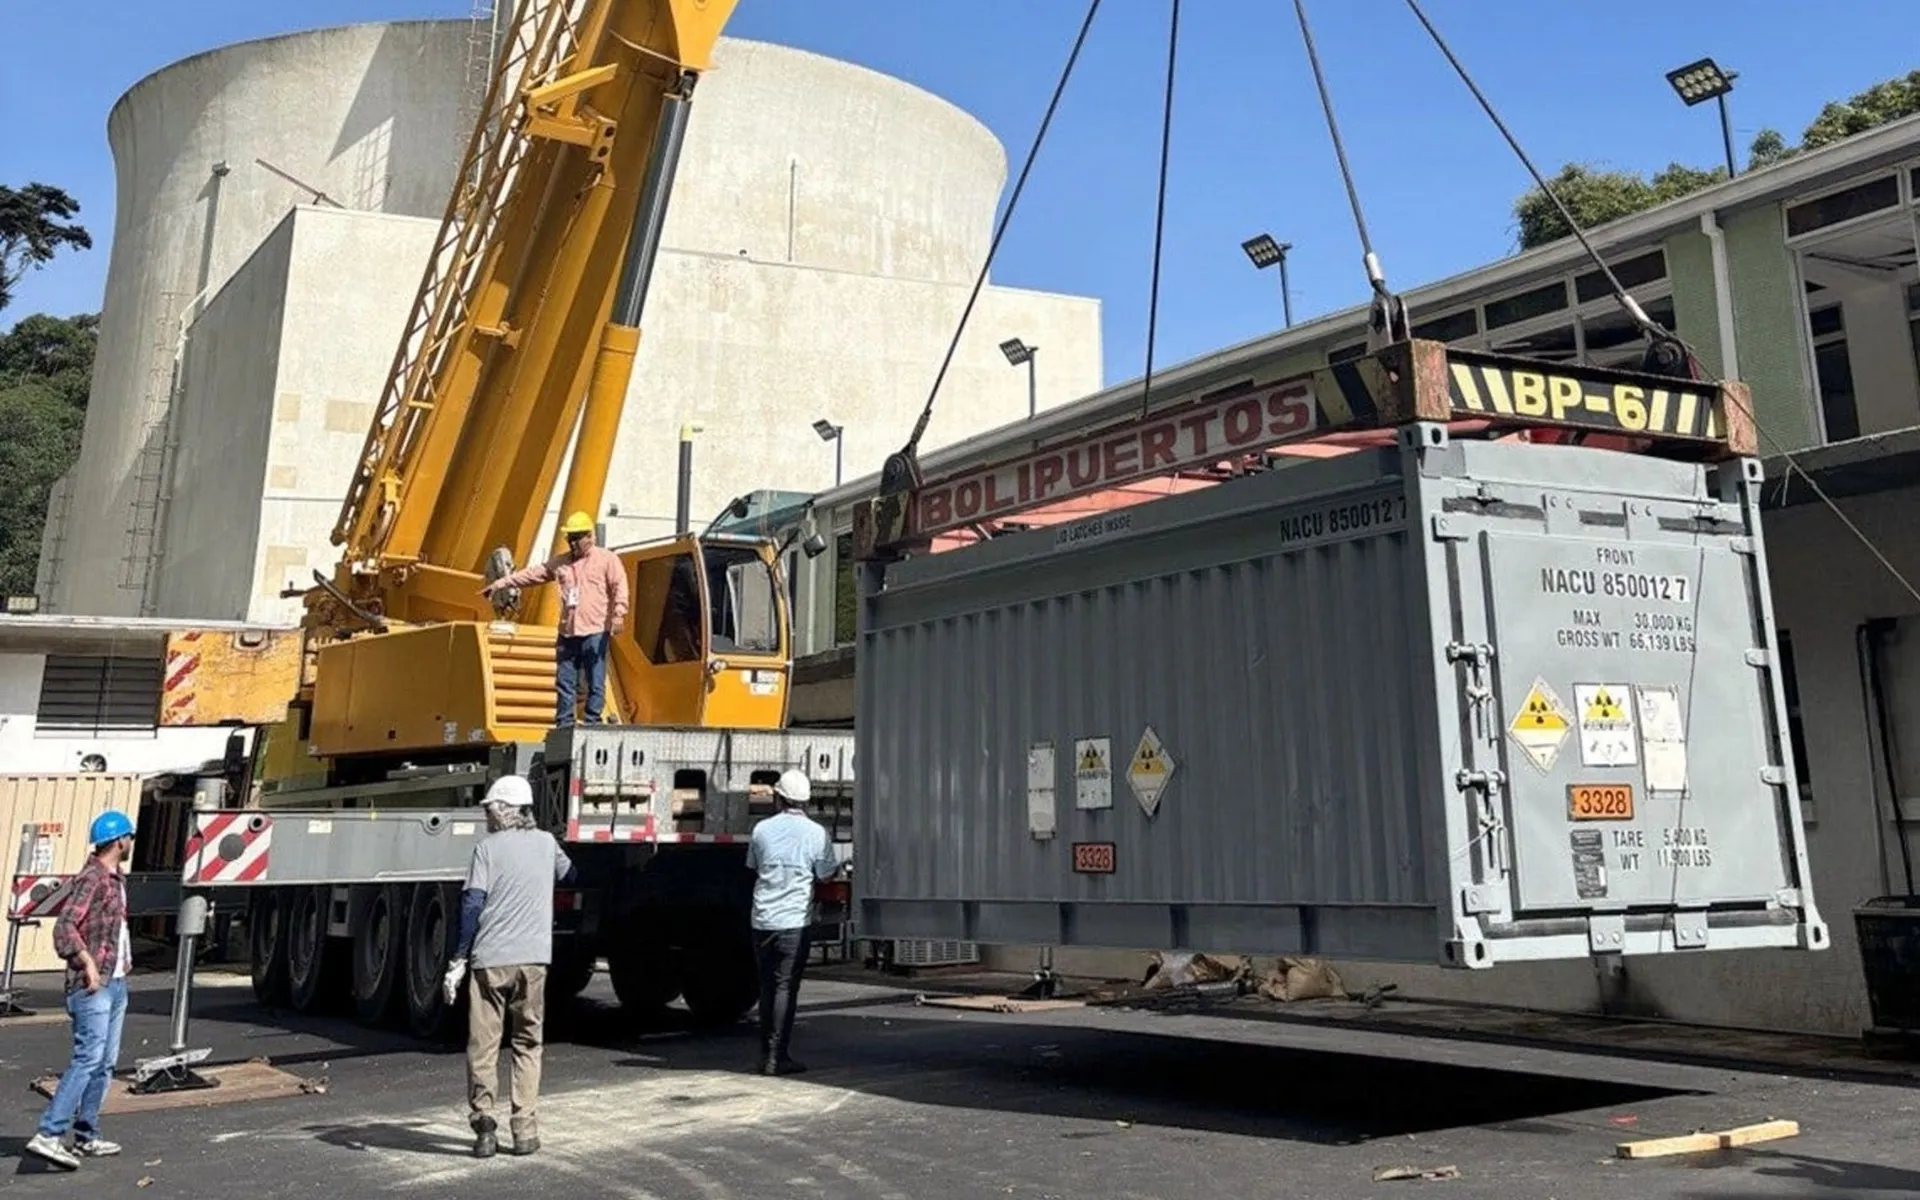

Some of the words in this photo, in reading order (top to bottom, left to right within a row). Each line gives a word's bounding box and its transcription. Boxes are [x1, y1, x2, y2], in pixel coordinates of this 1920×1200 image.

[1511, 371, 1649, 432] BP-6
[920, 384, 1311, 527] BOLIPUERTOS
[1280, 510, 1323, 542] NACU
[1596, 547, 1636, 565] FRONT
[1541, 568, 1596, 595] NACU
[1573, 609, 1601, 626] MAX
[1677, 616, 1692, 632] KG
[1557, 629, 1599, 648] GROSS
[1602, 631, 1620, 648] WT
[1673, 636, 1697, 653] LBS
[1579, 789, 1628, 815] 3328
[1612, 830, 1644, 848] TARE
[1694, 828, 1708, 846] KG
[1079, 847, 1111, 868] 3328
[1619, 853, 1640, 870] WT
[1693, 849, 1712, 867] LBS
